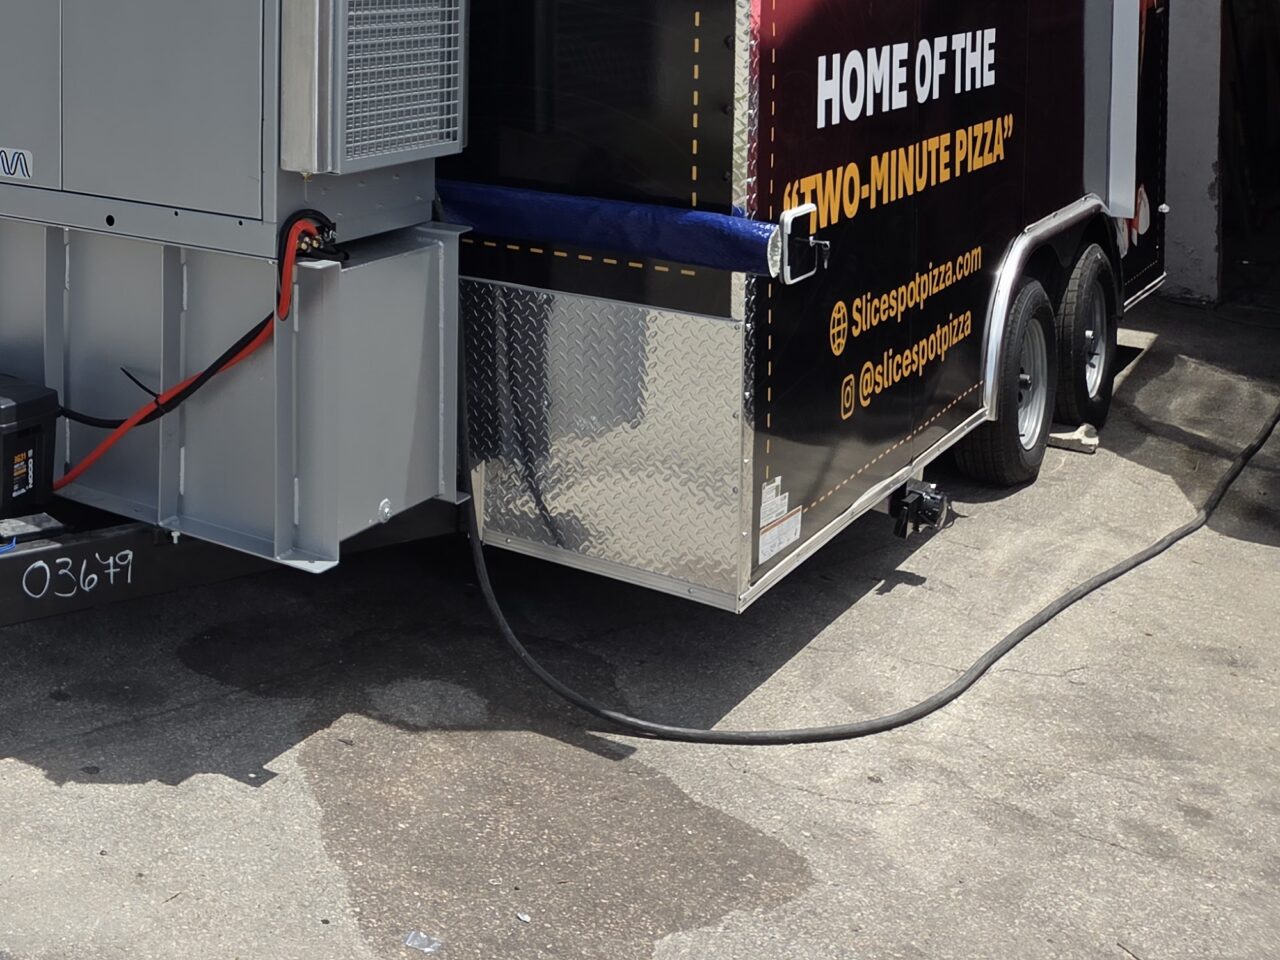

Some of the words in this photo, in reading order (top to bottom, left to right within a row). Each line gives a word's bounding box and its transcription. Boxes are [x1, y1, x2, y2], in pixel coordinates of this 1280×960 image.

[816, 41, 909, 129] HOME
[914, 35, 948, 104] OF
[951, 27, 996, 95] THE
[955, 113, 1014, 178] PIZZA”
[851, 245, 982, 338] Slicespotpizza.com
[859, 309, 972, 408] @slicespotpizza
